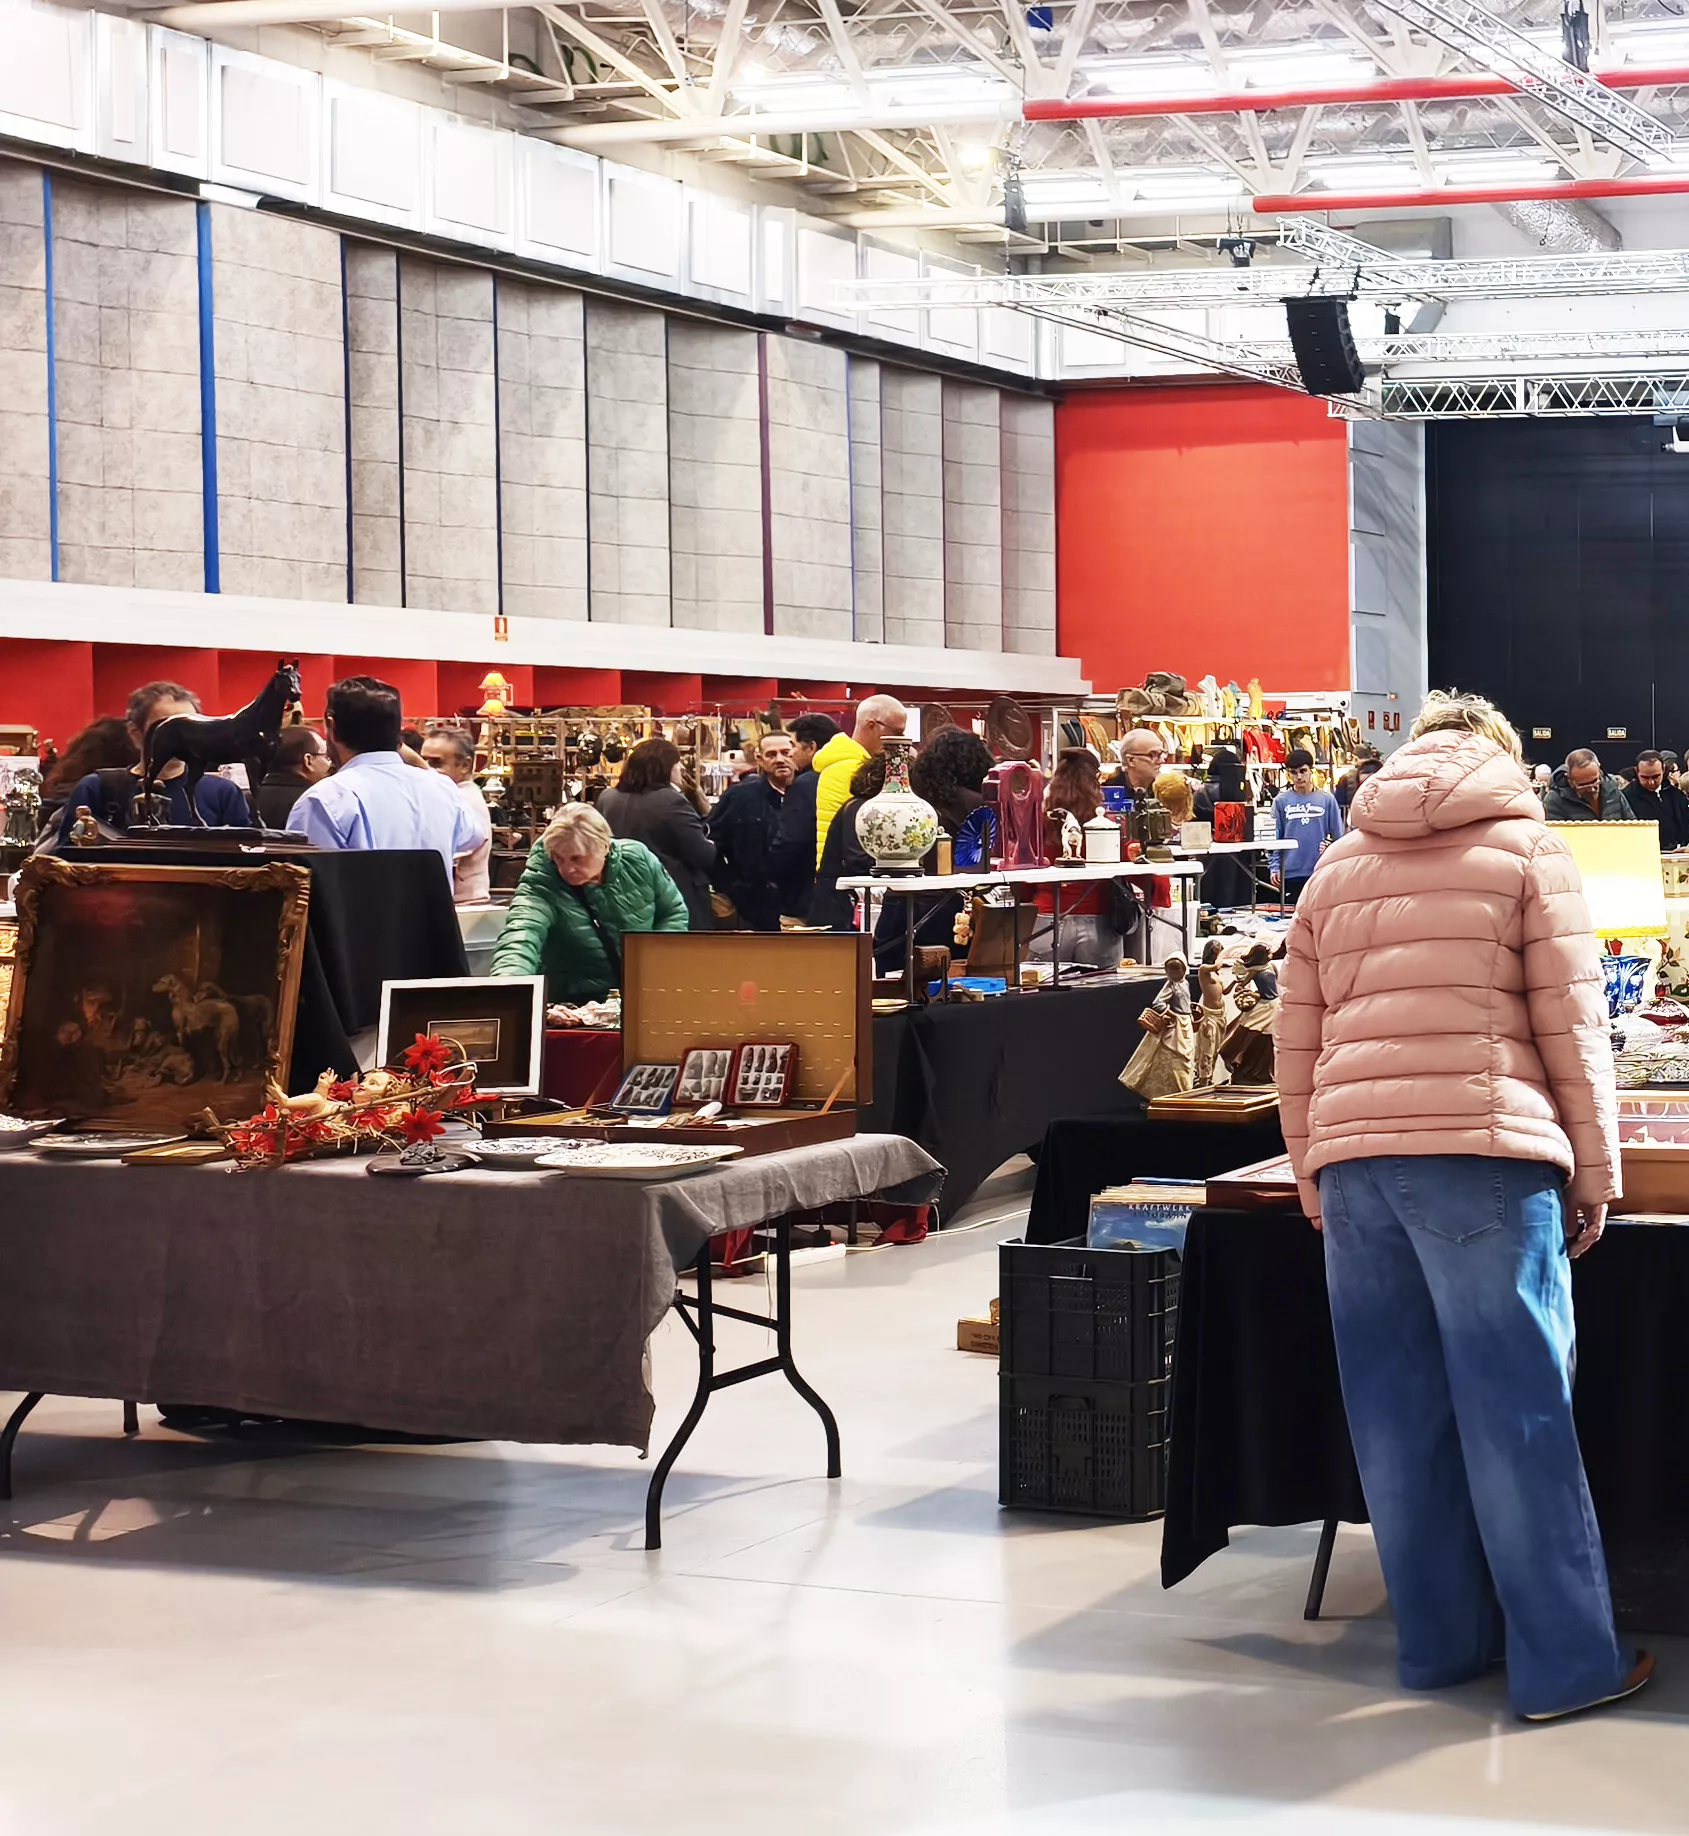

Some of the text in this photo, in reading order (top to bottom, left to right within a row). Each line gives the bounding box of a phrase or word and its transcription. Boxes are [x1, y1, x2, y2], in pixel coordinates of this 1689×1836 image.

[1607, 728, 1626, 736] SALIDA
[1128, 1204, 1192, 1212] KRAFTWERK
[1133, 1209, 1187, 1219] AUTOBAHN
